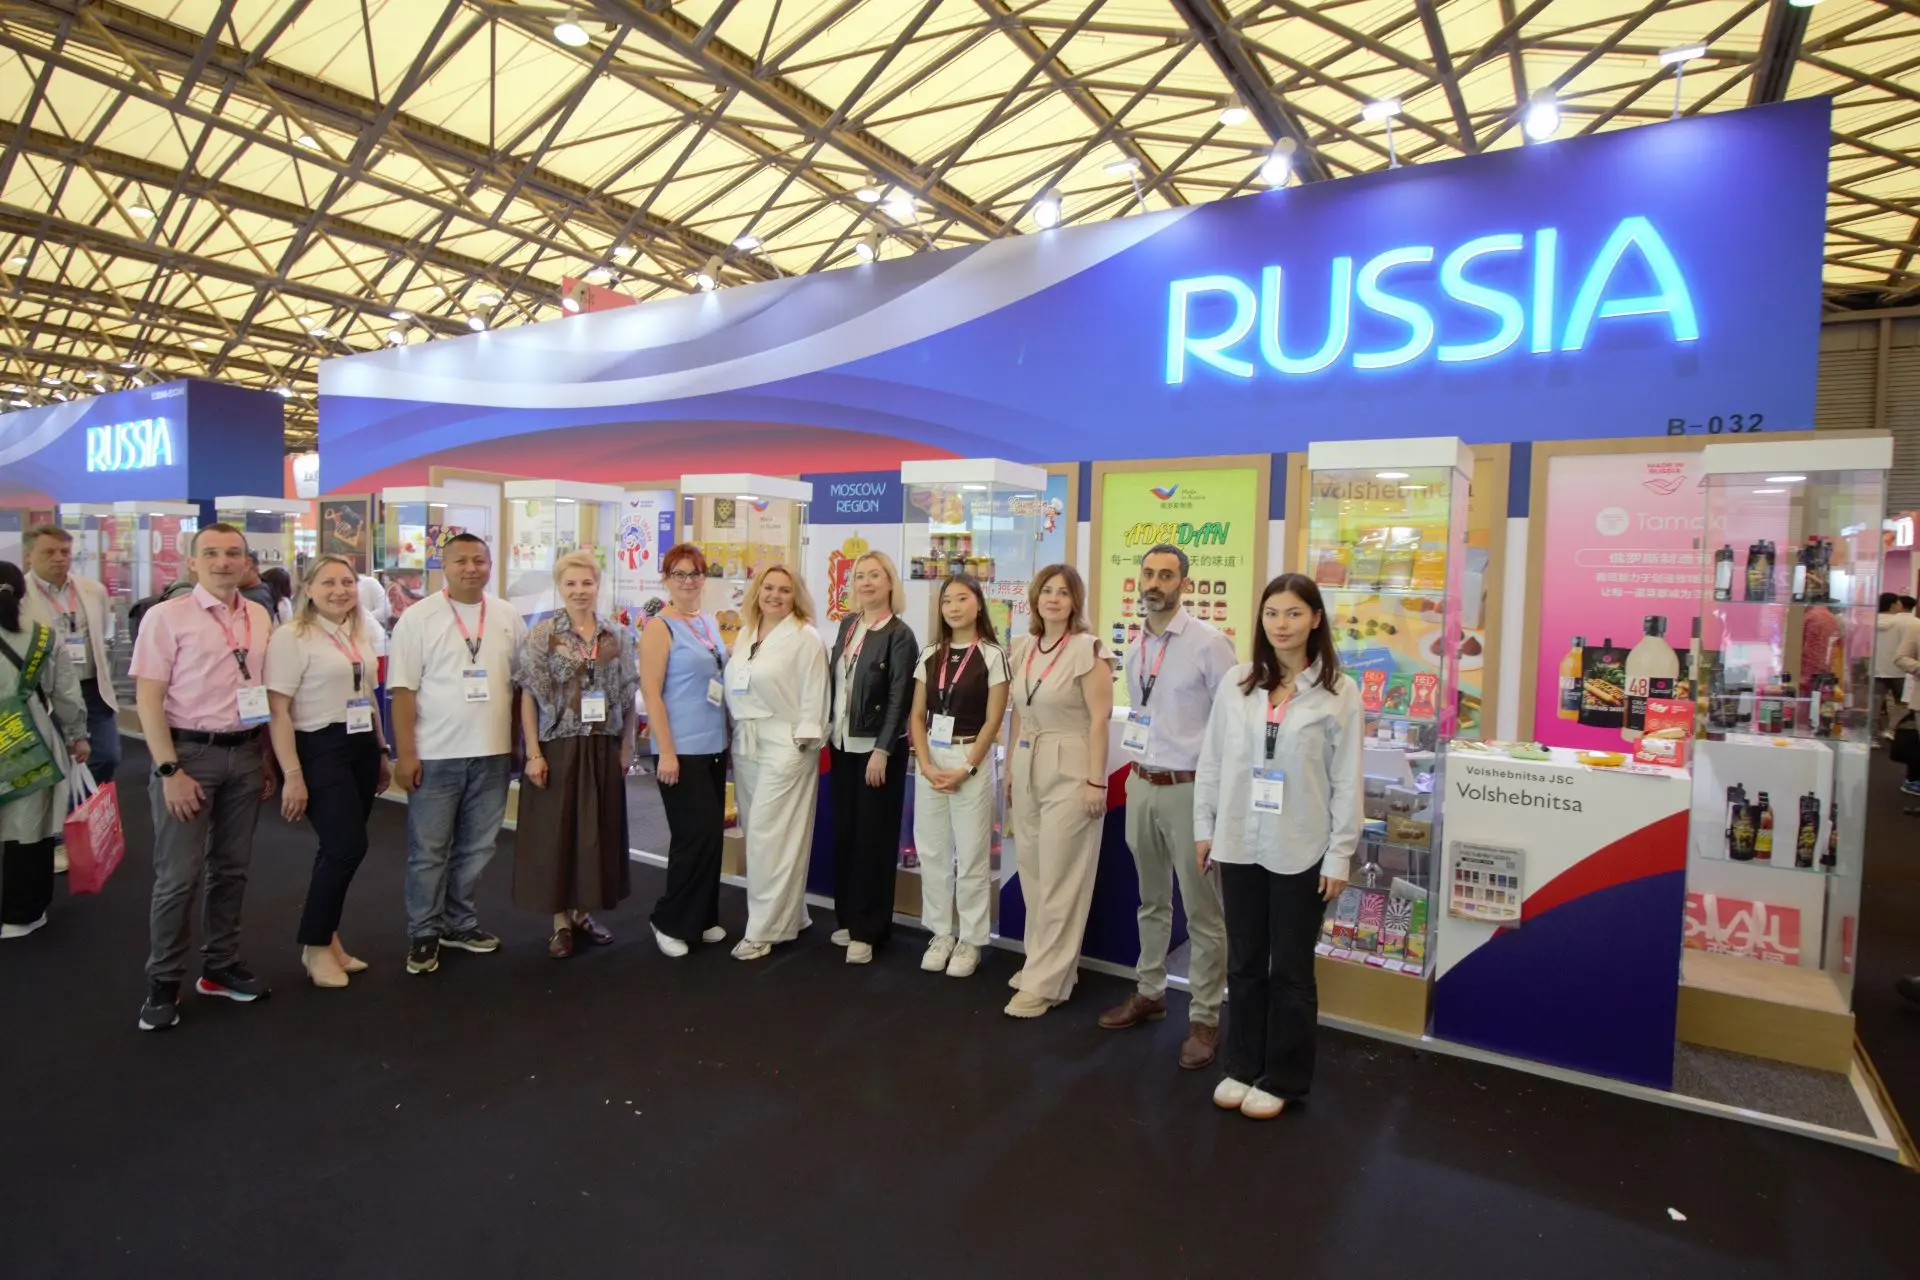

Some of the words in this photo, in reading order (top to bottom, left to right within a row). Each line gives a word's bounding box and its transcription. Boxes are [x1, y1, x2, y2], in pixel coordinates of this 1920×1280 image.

[1165, 216, 1699, 385] RUSSIA
[1667, 413, 1764, 436] B-032
[86, 416, 173, 472] RUSSIA
[830, 482, 887, 496] MOSCOW
[836, 499, 879, 513] REGION
[1414, 675, 1436, 684] RED
[1629, 678, 1647, 696] 48
[1465, 765, 1545, 782] Volshebnitsa
[1548, 774, 1575, 785] JSC
[1456, 781, 1583, 812] Volshebnitsa
[1684, 900, 1799, 954] SAL
